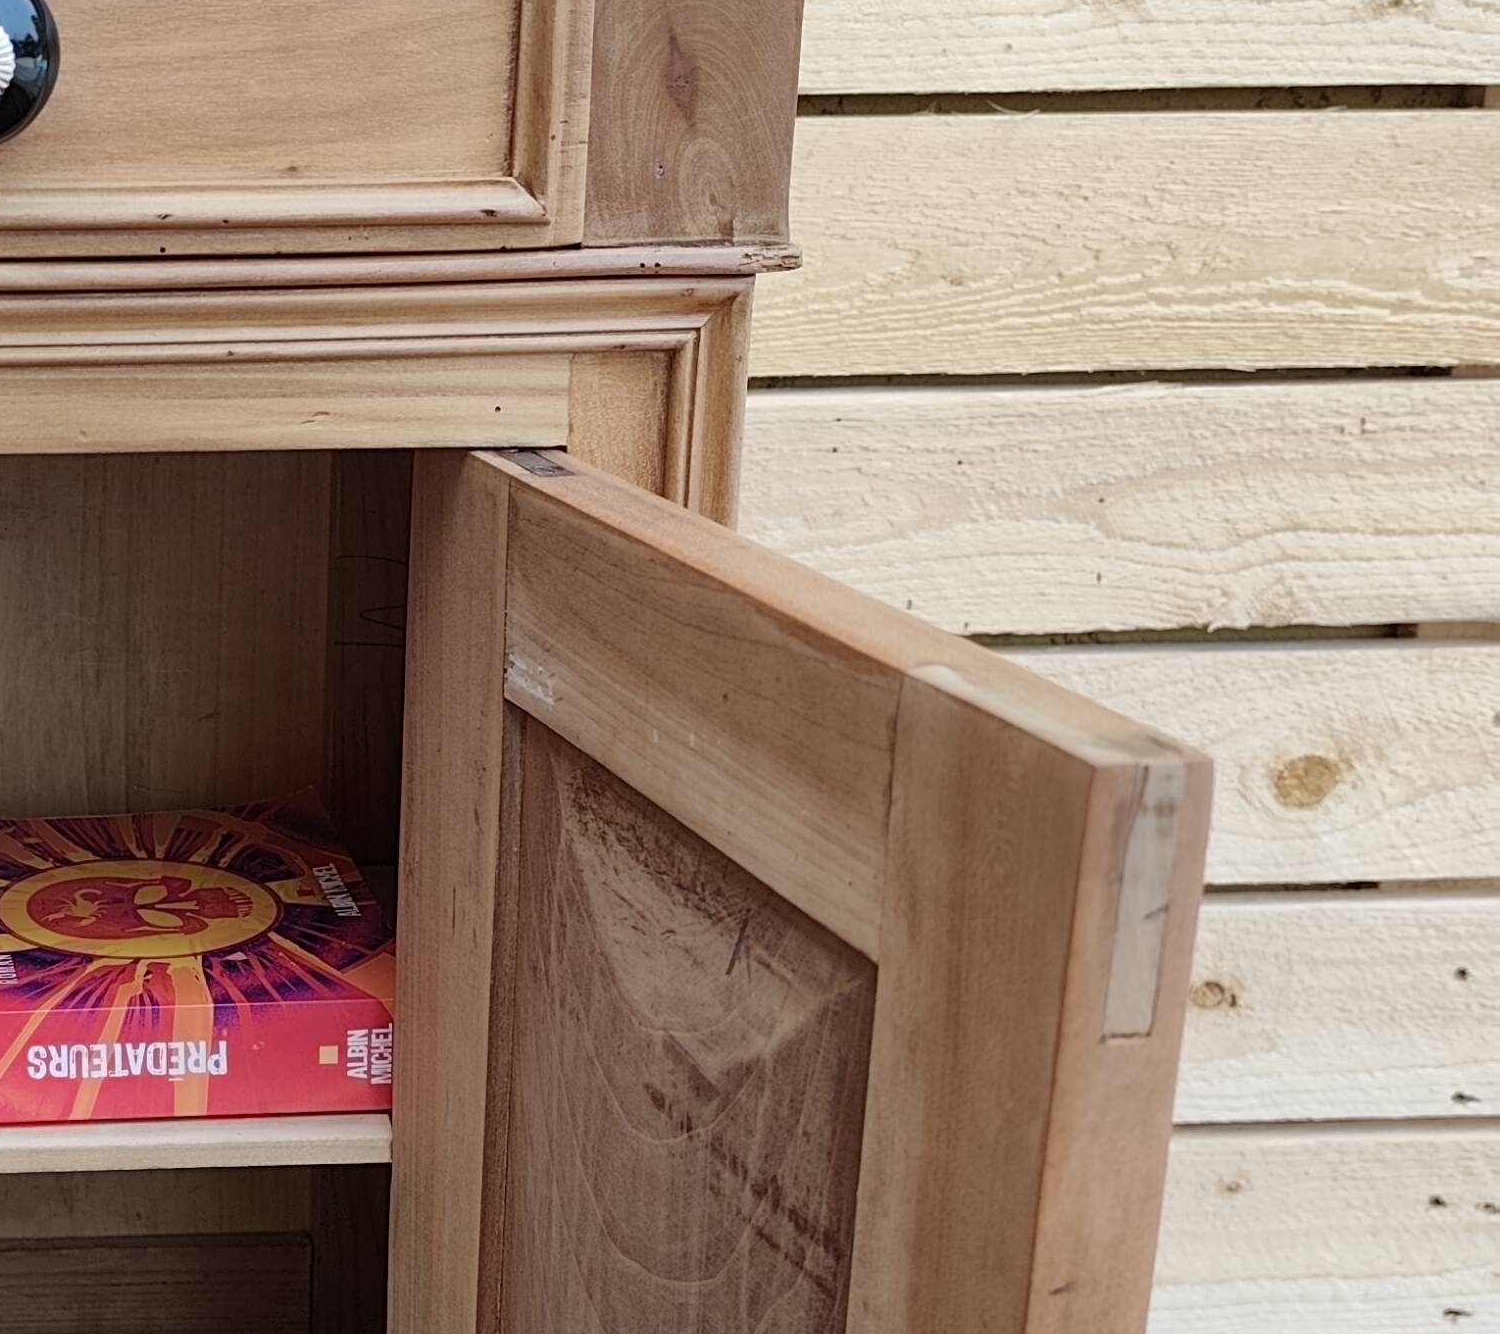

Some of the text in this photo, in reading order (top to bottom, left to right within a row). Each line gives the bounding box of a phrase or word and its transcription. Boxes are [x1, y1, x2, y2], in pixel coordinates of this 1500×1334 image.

[27, 1040, 229, 1081] PRÉDATEURS
[347, 1029, 369, 1079] ALBIN
[370, 1023, 393, 1085] MICHEL
